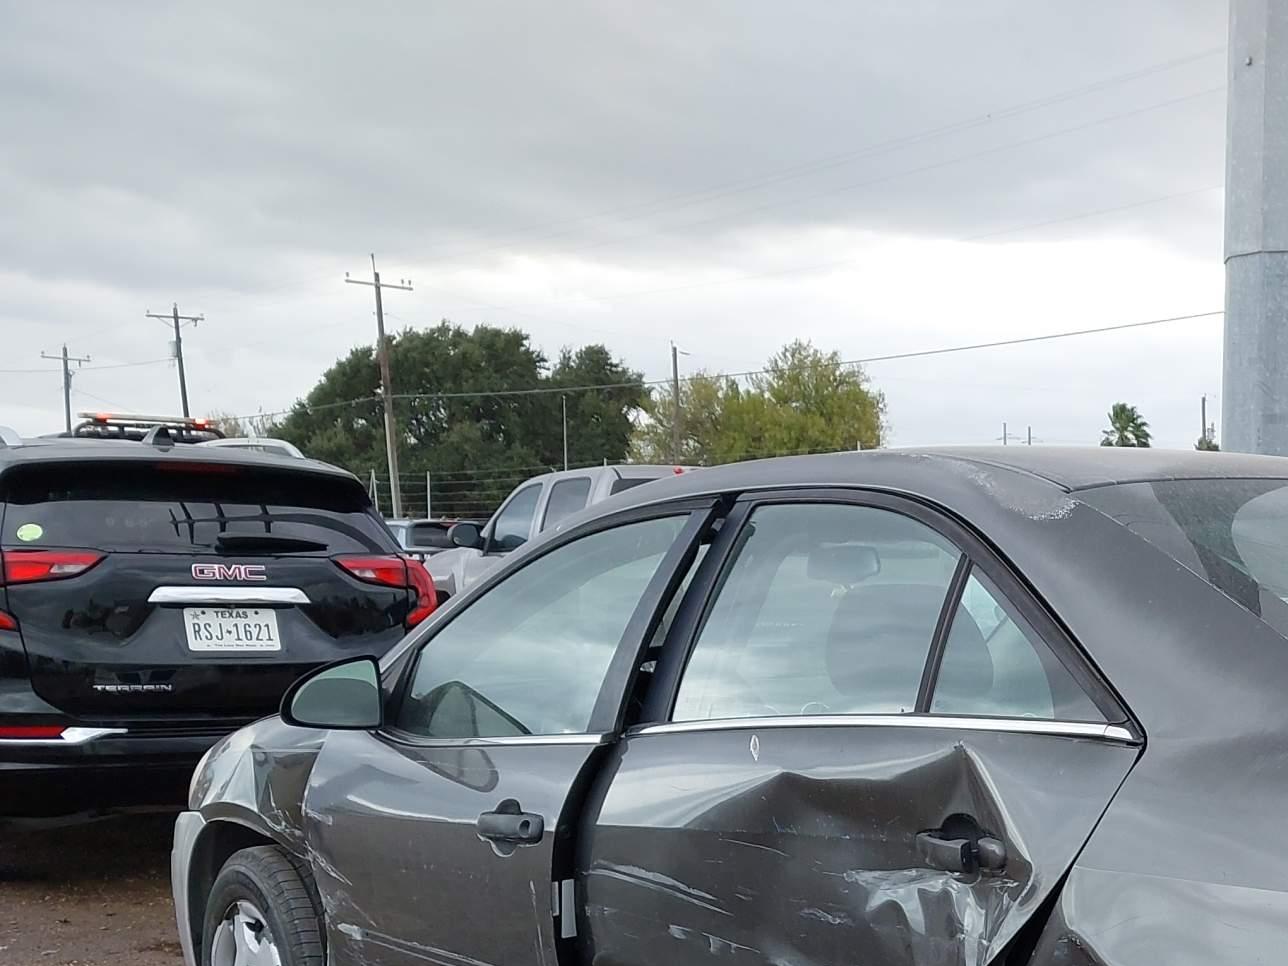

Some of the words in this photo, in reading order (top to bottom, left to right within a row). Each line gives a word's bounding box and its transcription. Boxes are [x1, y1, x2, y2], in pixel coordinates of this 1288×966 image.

[191, 563, 267, 582] GMC
[214, 610, 249, 619] TEXAS
[92, 684, 173, 692] TERRAIN
